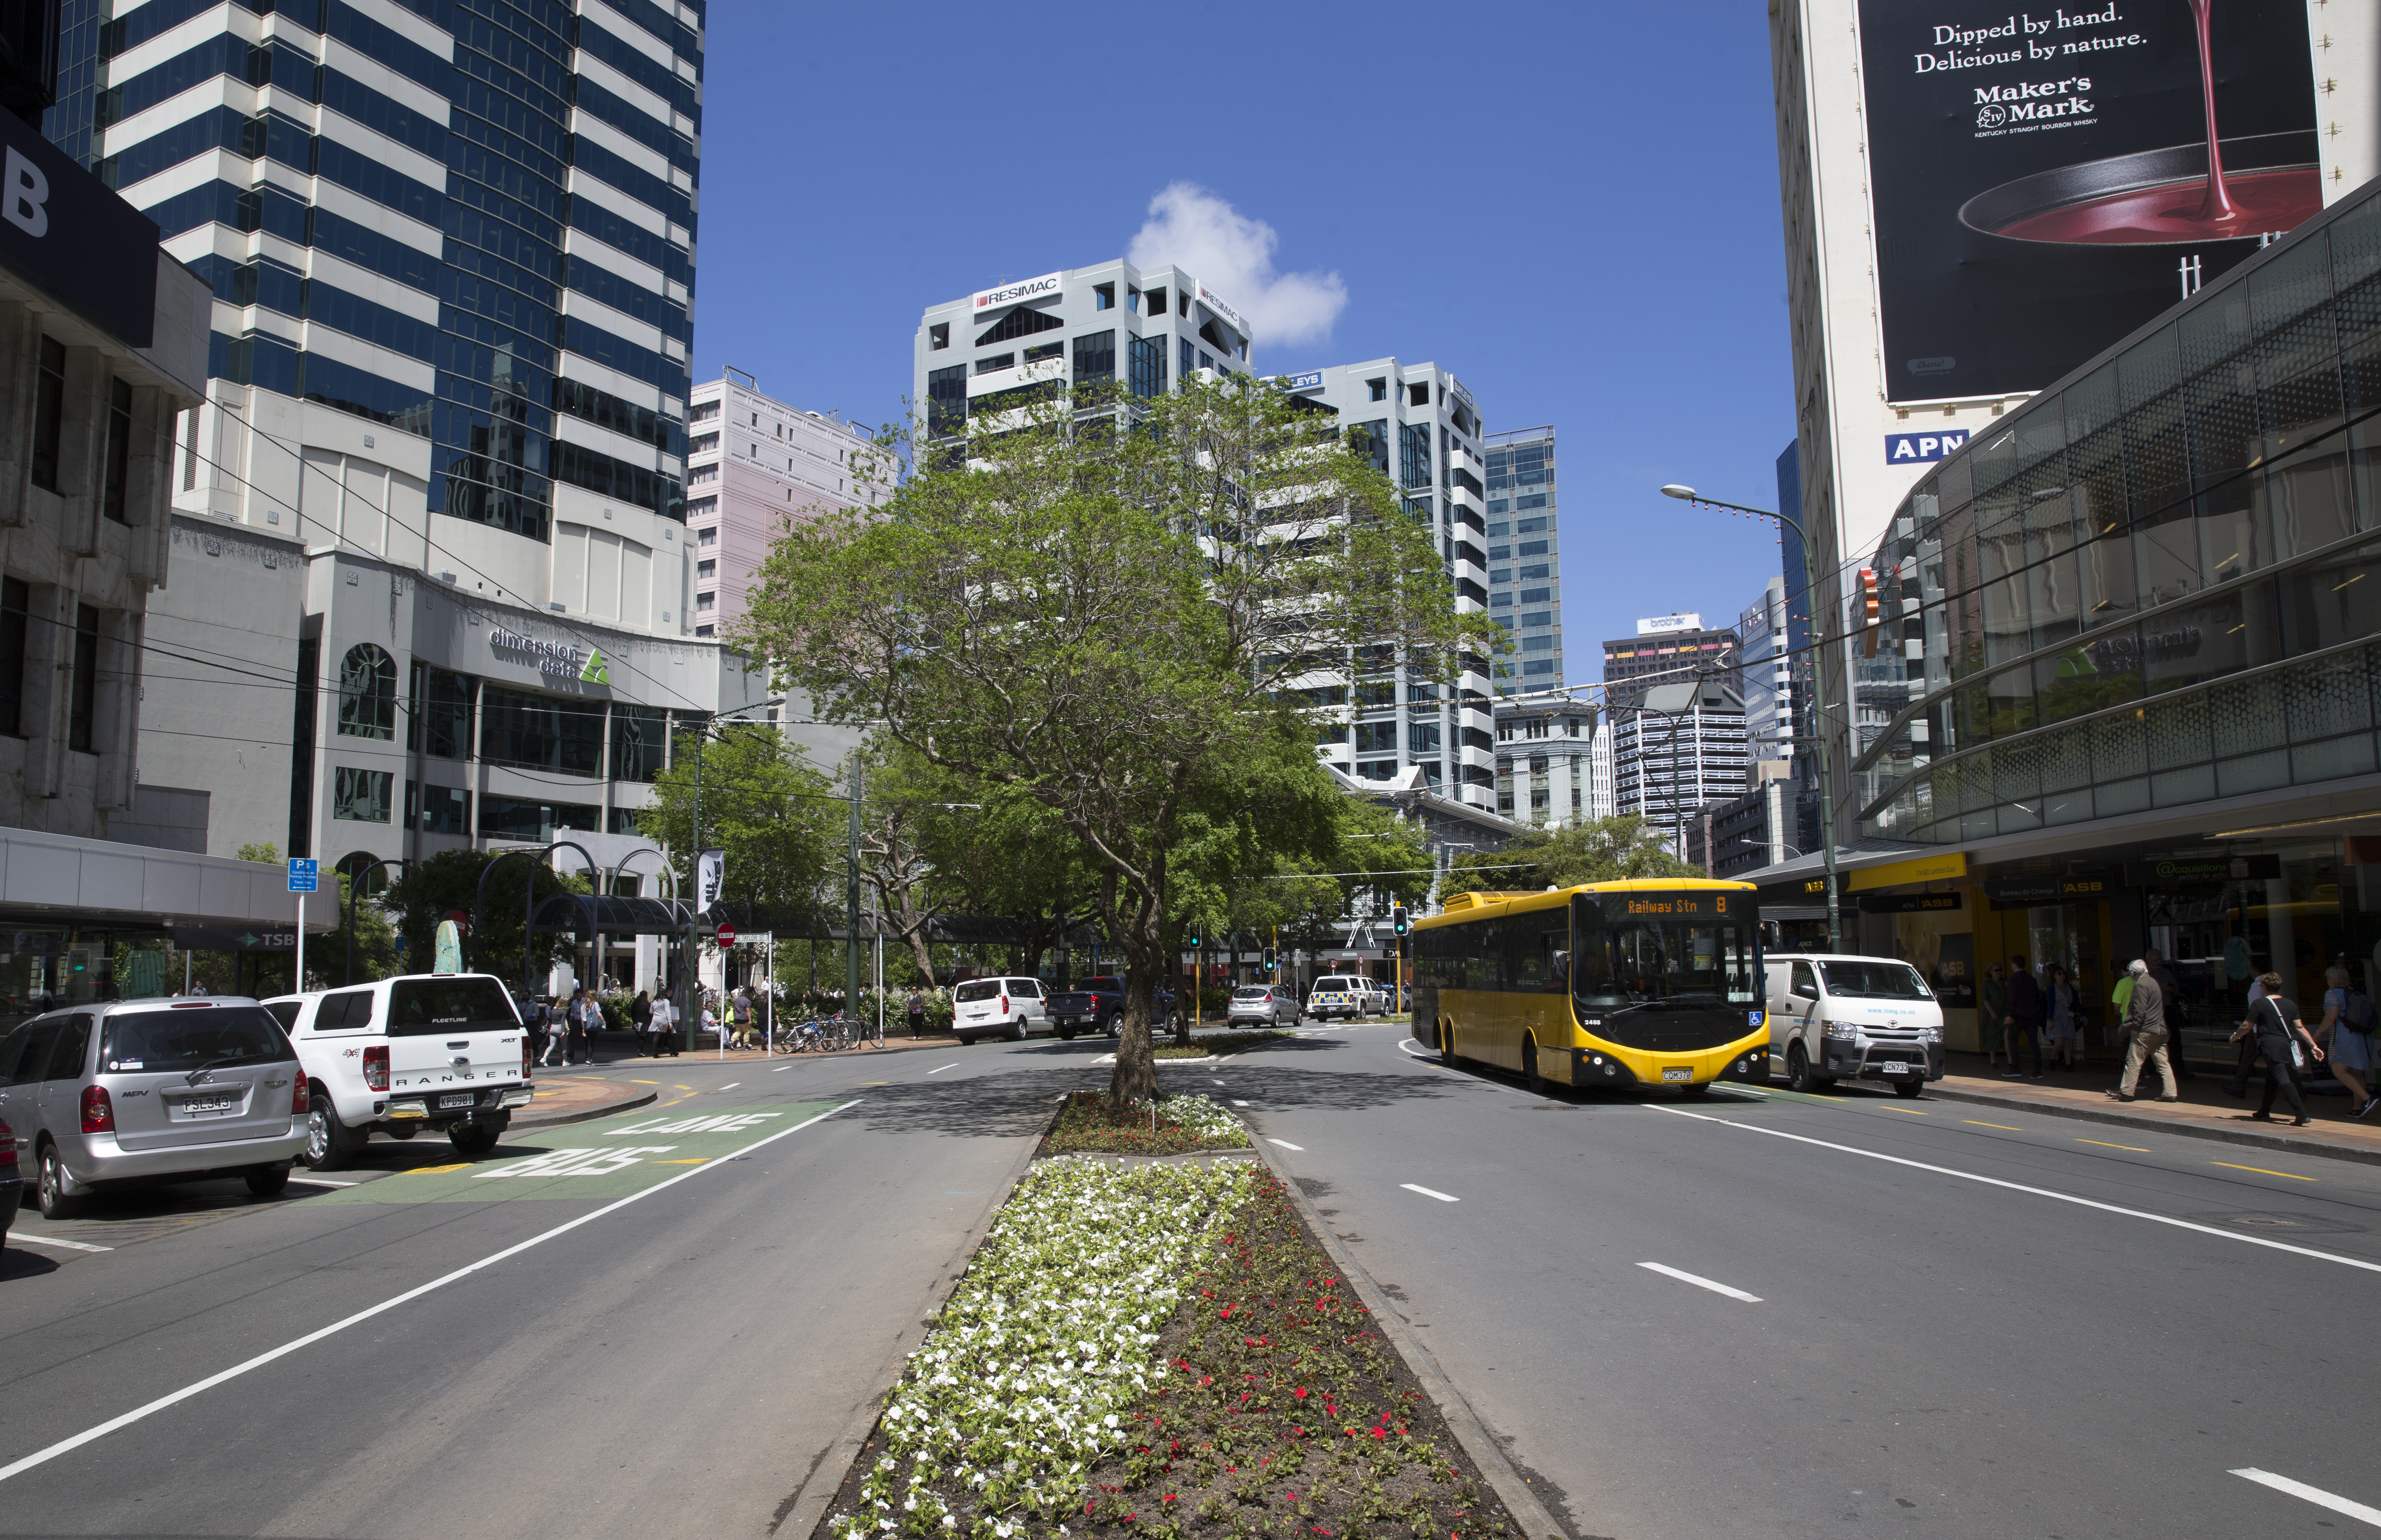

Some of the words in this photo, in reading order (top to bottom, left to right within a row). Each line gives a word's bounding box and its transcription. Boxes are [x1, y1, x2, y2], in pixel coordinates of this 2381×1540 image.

[1933, 16, 2016, 45] Dipped
[2022, 14, 2051, 35] by
[2056, 1, 2123, 29] hand.
[1915, 49, 2022, 73] Delicious
[2028, 40, 2056, 60] by
[2063, 34, 2147, 54] nature.
[1974, 77, 2091, 104] Maker's
[2009, 97, 2089, 122] Mark
[1974, 129, 2007, 138] KENTUCKY
[2009, 126, 2039, 134] STRAIGHT
[2041, 122, 2071, 130] BOURBON
[2073, 118, 2098, 126] WHISKY
[989, 278, 1057, 304] RESIMAC
[1206, 291, 1237, 322] RESIMAC
[1917, 359, 1945, 369] Cheers!
[1454, 382, 1472, 404] BAYLEYS
[1650, 617, 1685, 627] brother
[489, 627, 578, 662] dimension
[539, 657, 577, 679] data
[296, 860, 305, 869] P
[1929, 867, 1946, 876] Lambton
[1946, 866, 1956, 874] Quay
[2156, 861, 2227, 877] @cquisitions
[1805, 881, 1824, 893] ASB
[2063, 882, 2103, 893] ASB
[1629, 901, 1672, 913] Railway
[1677, 900, 1697, 912] Stn
[1921, 898, 1953, 908] ASB
[262, 934, 295, 946] TSB
[1941, 961, 1965, 976] ASB
[1883, 1063, 1908, 1071] KCN733
[396, 1070, 518, 1086] RANGER
[1664, 1071, 1691, 1080] CQM370
[121, 1090, 149, 1098] MPV
[441, 1095, 472, 1107] KPD901
[185, 1096, 229, 1111] FSL343
[602, 1113, 784, 1135] LANE
[470, 1146, 679, 1178] BUS
